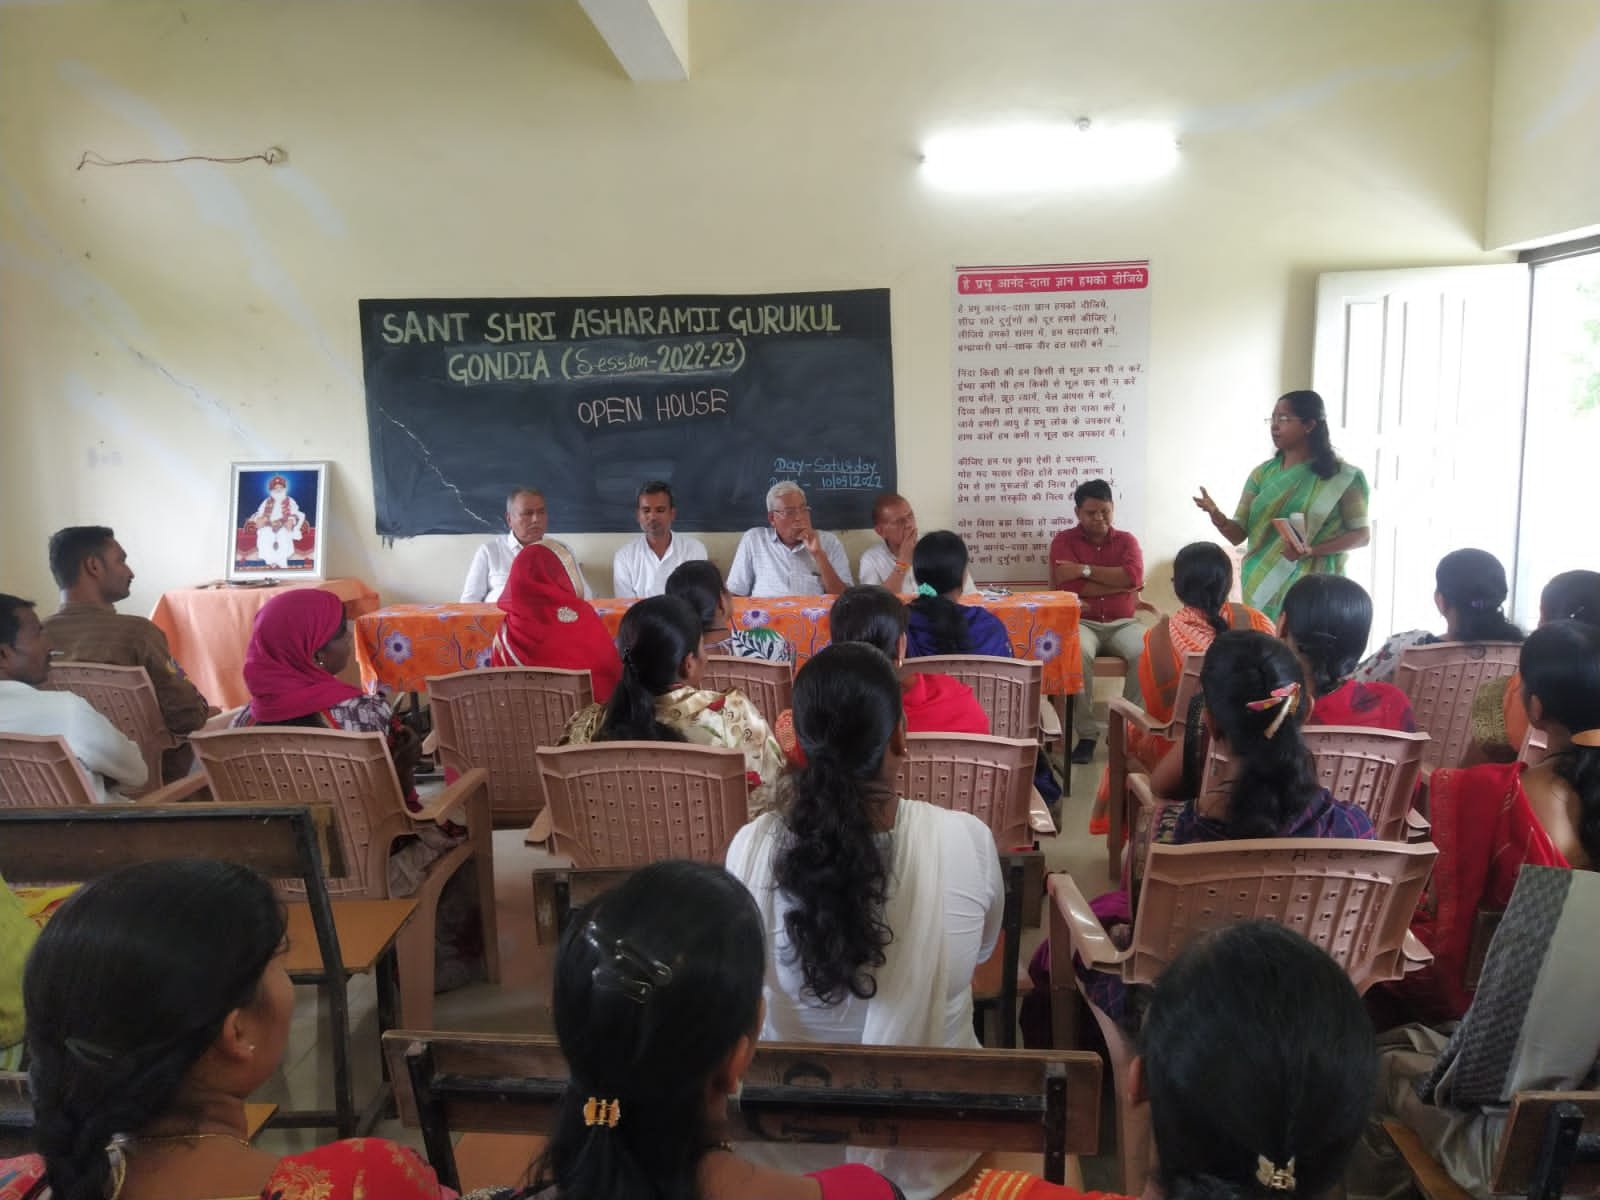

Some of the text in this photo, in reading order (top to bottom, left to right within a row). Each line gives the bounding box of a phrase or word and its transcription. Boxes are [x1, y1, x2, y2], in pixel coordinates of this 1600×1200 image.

[962, 270, 1144, 292] हे प्रभु आनंद-दाता ज्ञान हमको दीजिये
[381, 303, 841, 344] SANT SHRI ASHARAMJI GURUKUL
[448, 348, 551, 384] GONDIA
[577, 389, 730, 428] OPEN HOUSE
